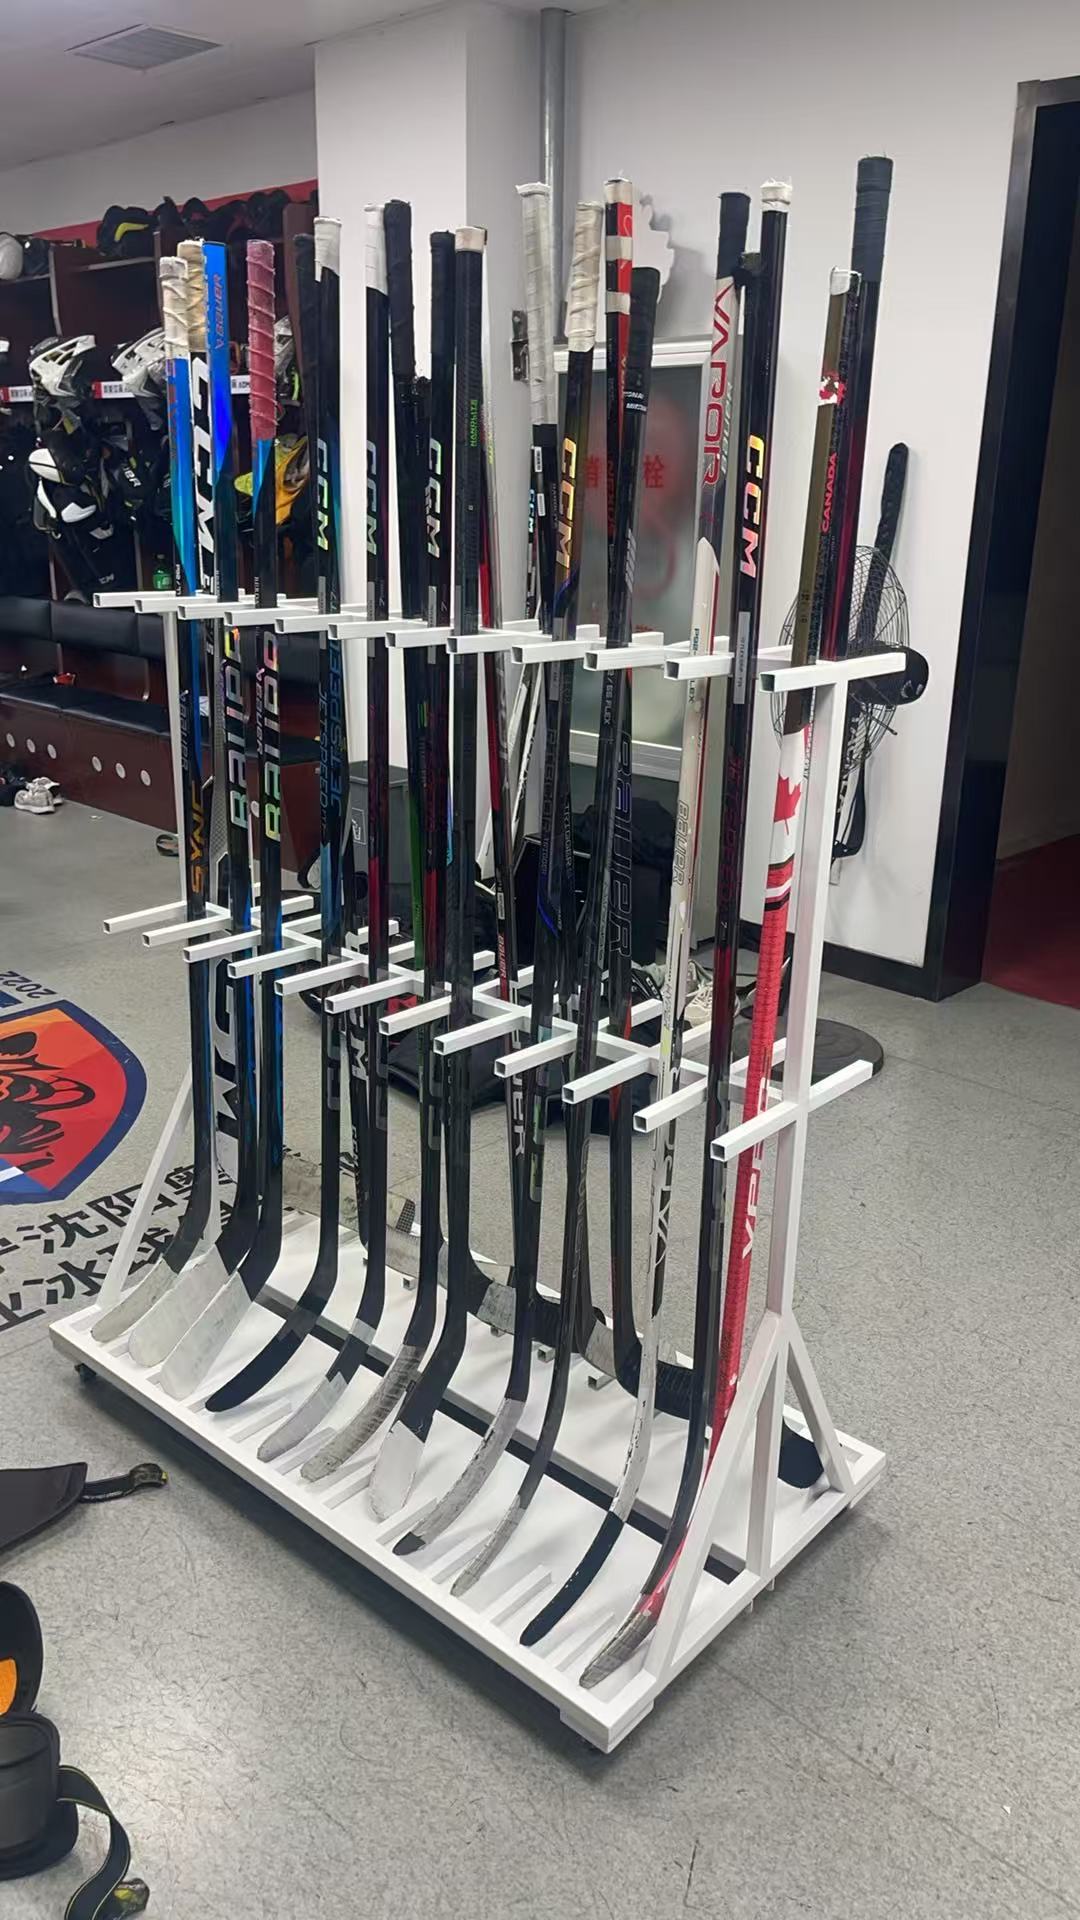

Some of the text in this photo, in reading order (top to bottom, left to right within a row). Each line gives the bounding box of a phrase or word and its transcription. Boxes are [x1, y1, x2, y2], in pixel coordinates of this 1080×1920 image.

[703, 282, 736, 487] VAPOR
[192, 356, 216, 548] CCM
[317, 437, 328, 551] CCM
[366, 439, 377, 555] CCM
[428, 436, 442, 559] CCM
[555, 437, 577, 569] CCM
[740, 434, 765, 579] CCM
[821, 452, 838, 534] CANADA
[608, 730, 633, 959] BAUER
[673, 800, 689, 887] BAUER
